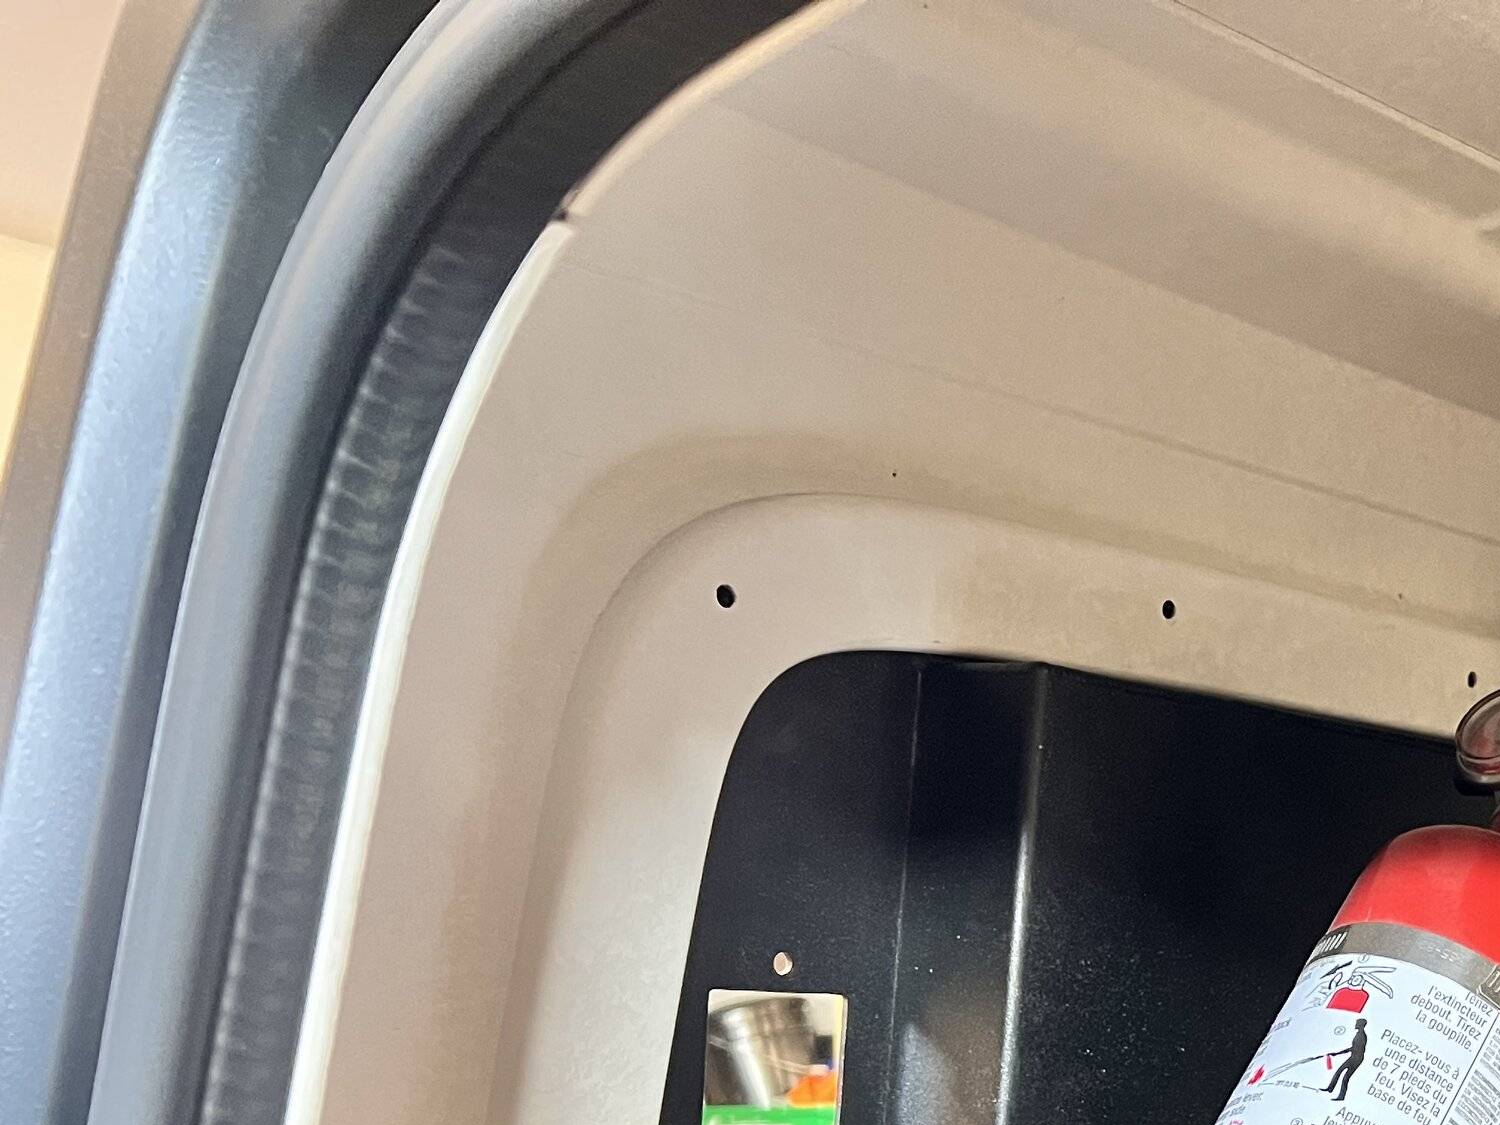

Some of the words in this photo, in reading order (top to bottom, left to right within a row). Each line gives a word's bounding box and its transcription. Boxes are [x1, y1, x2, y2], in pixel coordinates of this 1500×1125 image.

[1410, 994, 1452, 1022] debout.
[1456, 1015, 1482, 1041] Tirez
[1427, 985, 1488, 1028] l'extincteur
[1415, 1010, 1426, 1023] la
[1428, 1018, 1472, 1052] goupille.
[1372, 1057, 1388, 1071] de
[1390, 1063, 1401, 1075] 7
[1399, 1070, 1432, 1094] pieds
[1432, 1089, 1447, 1105] du
[1384, 1047, 1407, 1064] une
[1408, 1059, 1454, 1092] distance
[1425, 1051, 1452, 1074] vous
[1452, 1067, 1460, 1080] à
[1367, 1083, 1396, 1105] base
[1397, 1100, 1412, 1114] de
[1375, 1071, 1395, 1091] feu.
[1401, 1083, 1430, 1110] Visez
[1430, 1103, 1441, 1117] la
